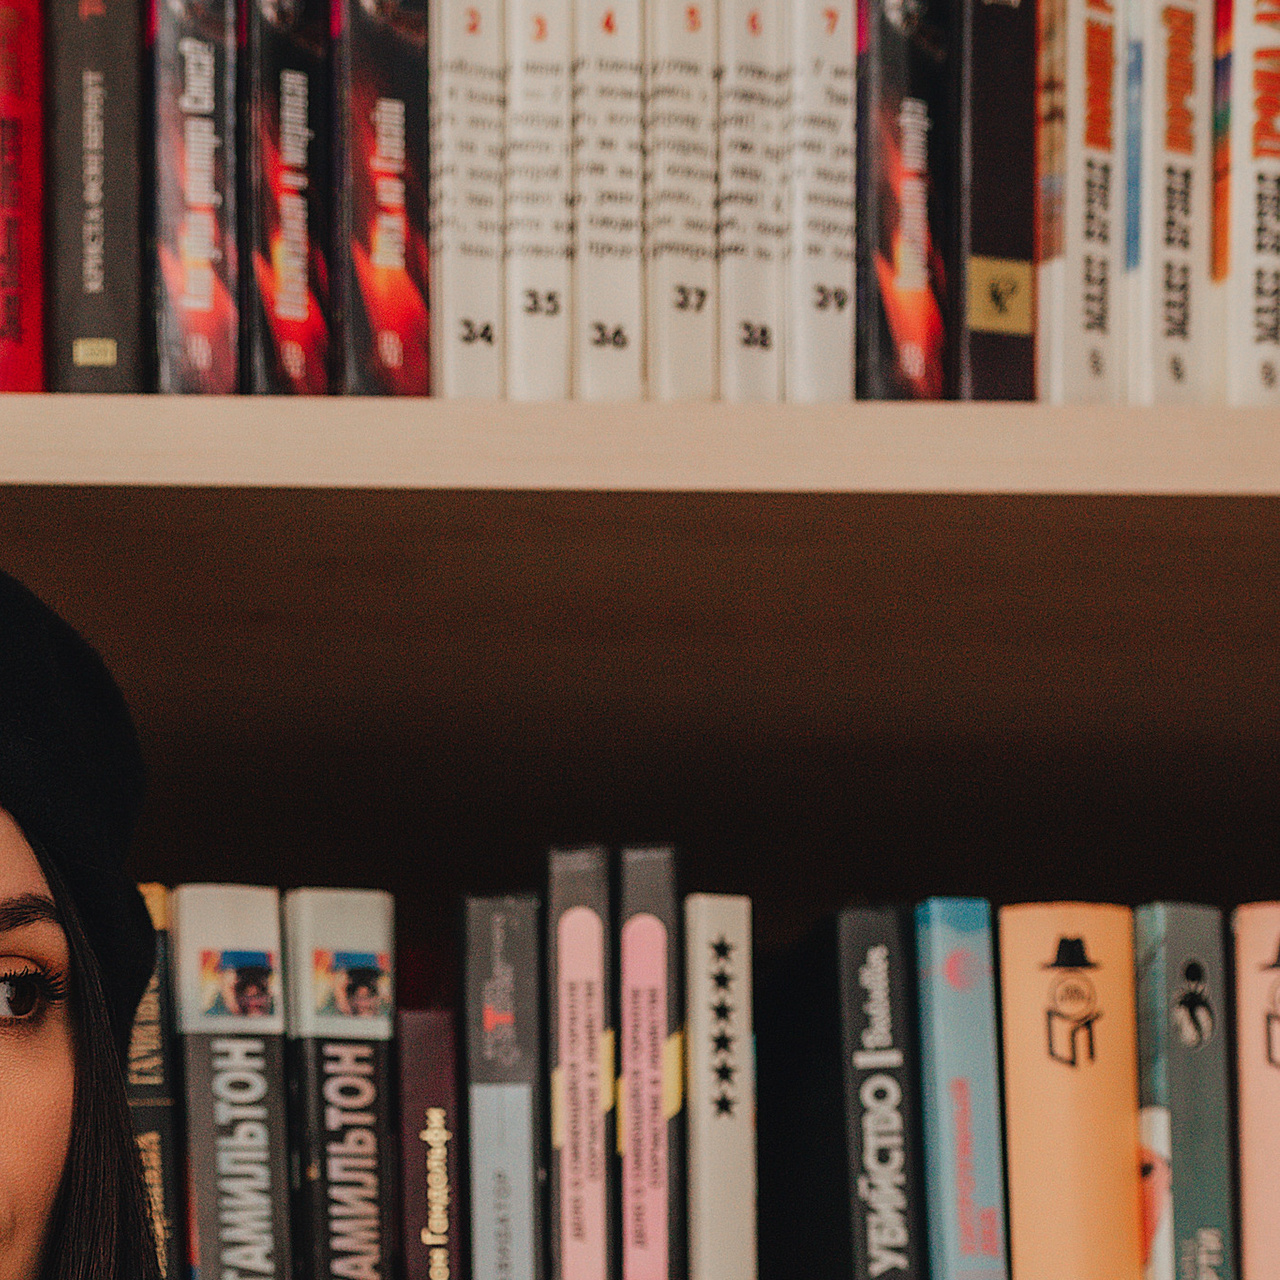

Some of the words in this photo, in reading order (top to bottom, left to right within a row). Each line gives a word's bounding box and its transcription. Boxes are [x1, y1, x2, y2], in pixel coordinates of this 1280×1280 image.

[524, 288, 561, 316] 35
[673, 283, 709, 313] 37
[814, 282, 848, 312] 39
[460, 318, 494, 346] 34
[591, 320, 628, 349] 36
[740, 320, 773, 351] 38
[420, 1107, 453, 1244] Гандольфи
[857, 1075, 909, 1277] УБИЙСТВО
